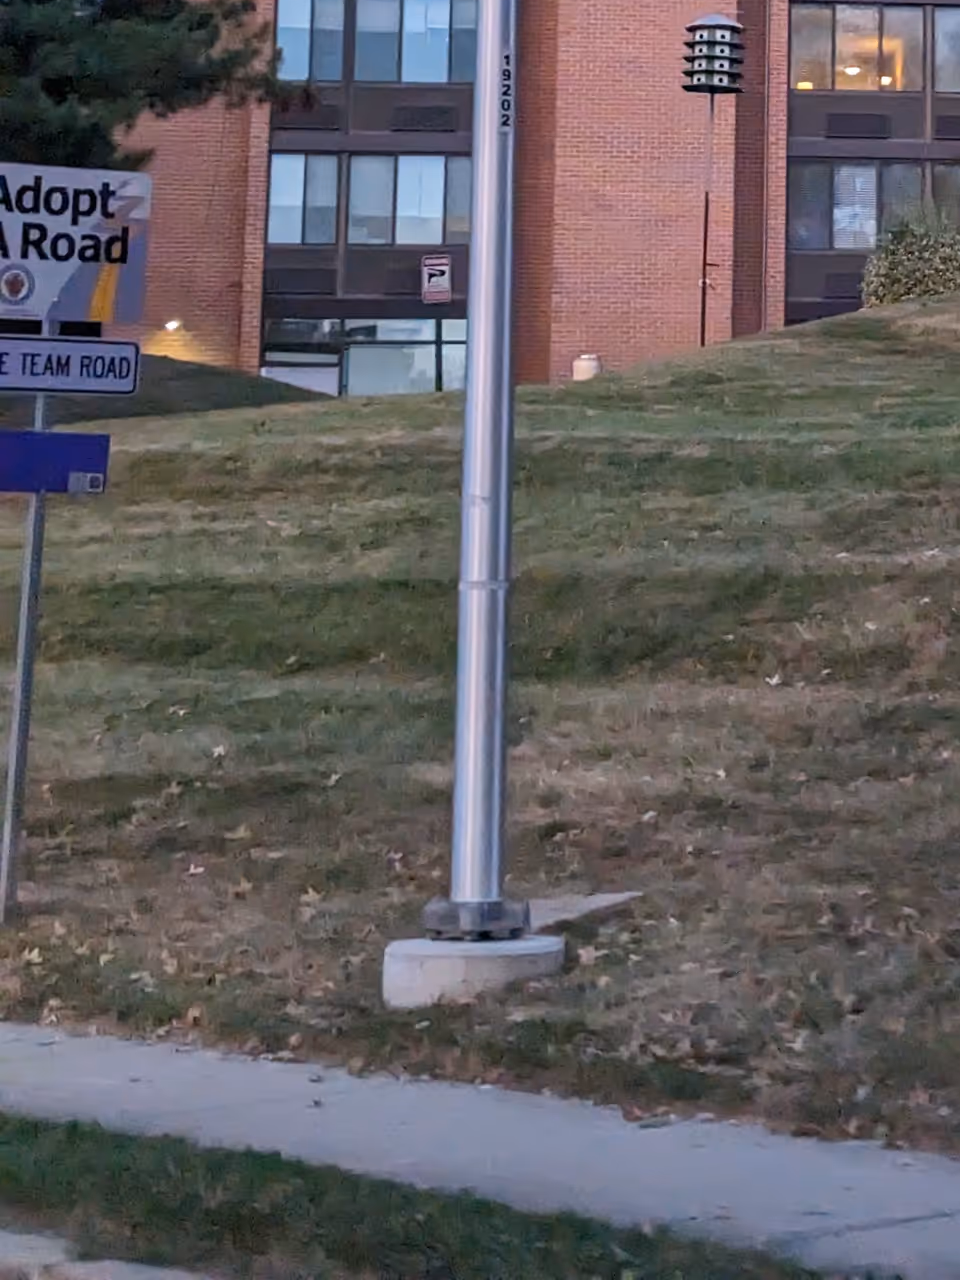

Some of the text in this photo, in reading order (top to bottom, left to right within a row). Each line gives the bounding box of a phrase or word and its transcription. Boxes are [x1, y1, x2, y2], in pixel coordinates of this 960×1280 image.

[501, 54, 511, 127] 19202
[0, 175, 117, 226] Adopt
[20, 222, 130, 265] Road
[20, 352, 71, 377] TEAM
[79, 355, 131, 379] ROAD
